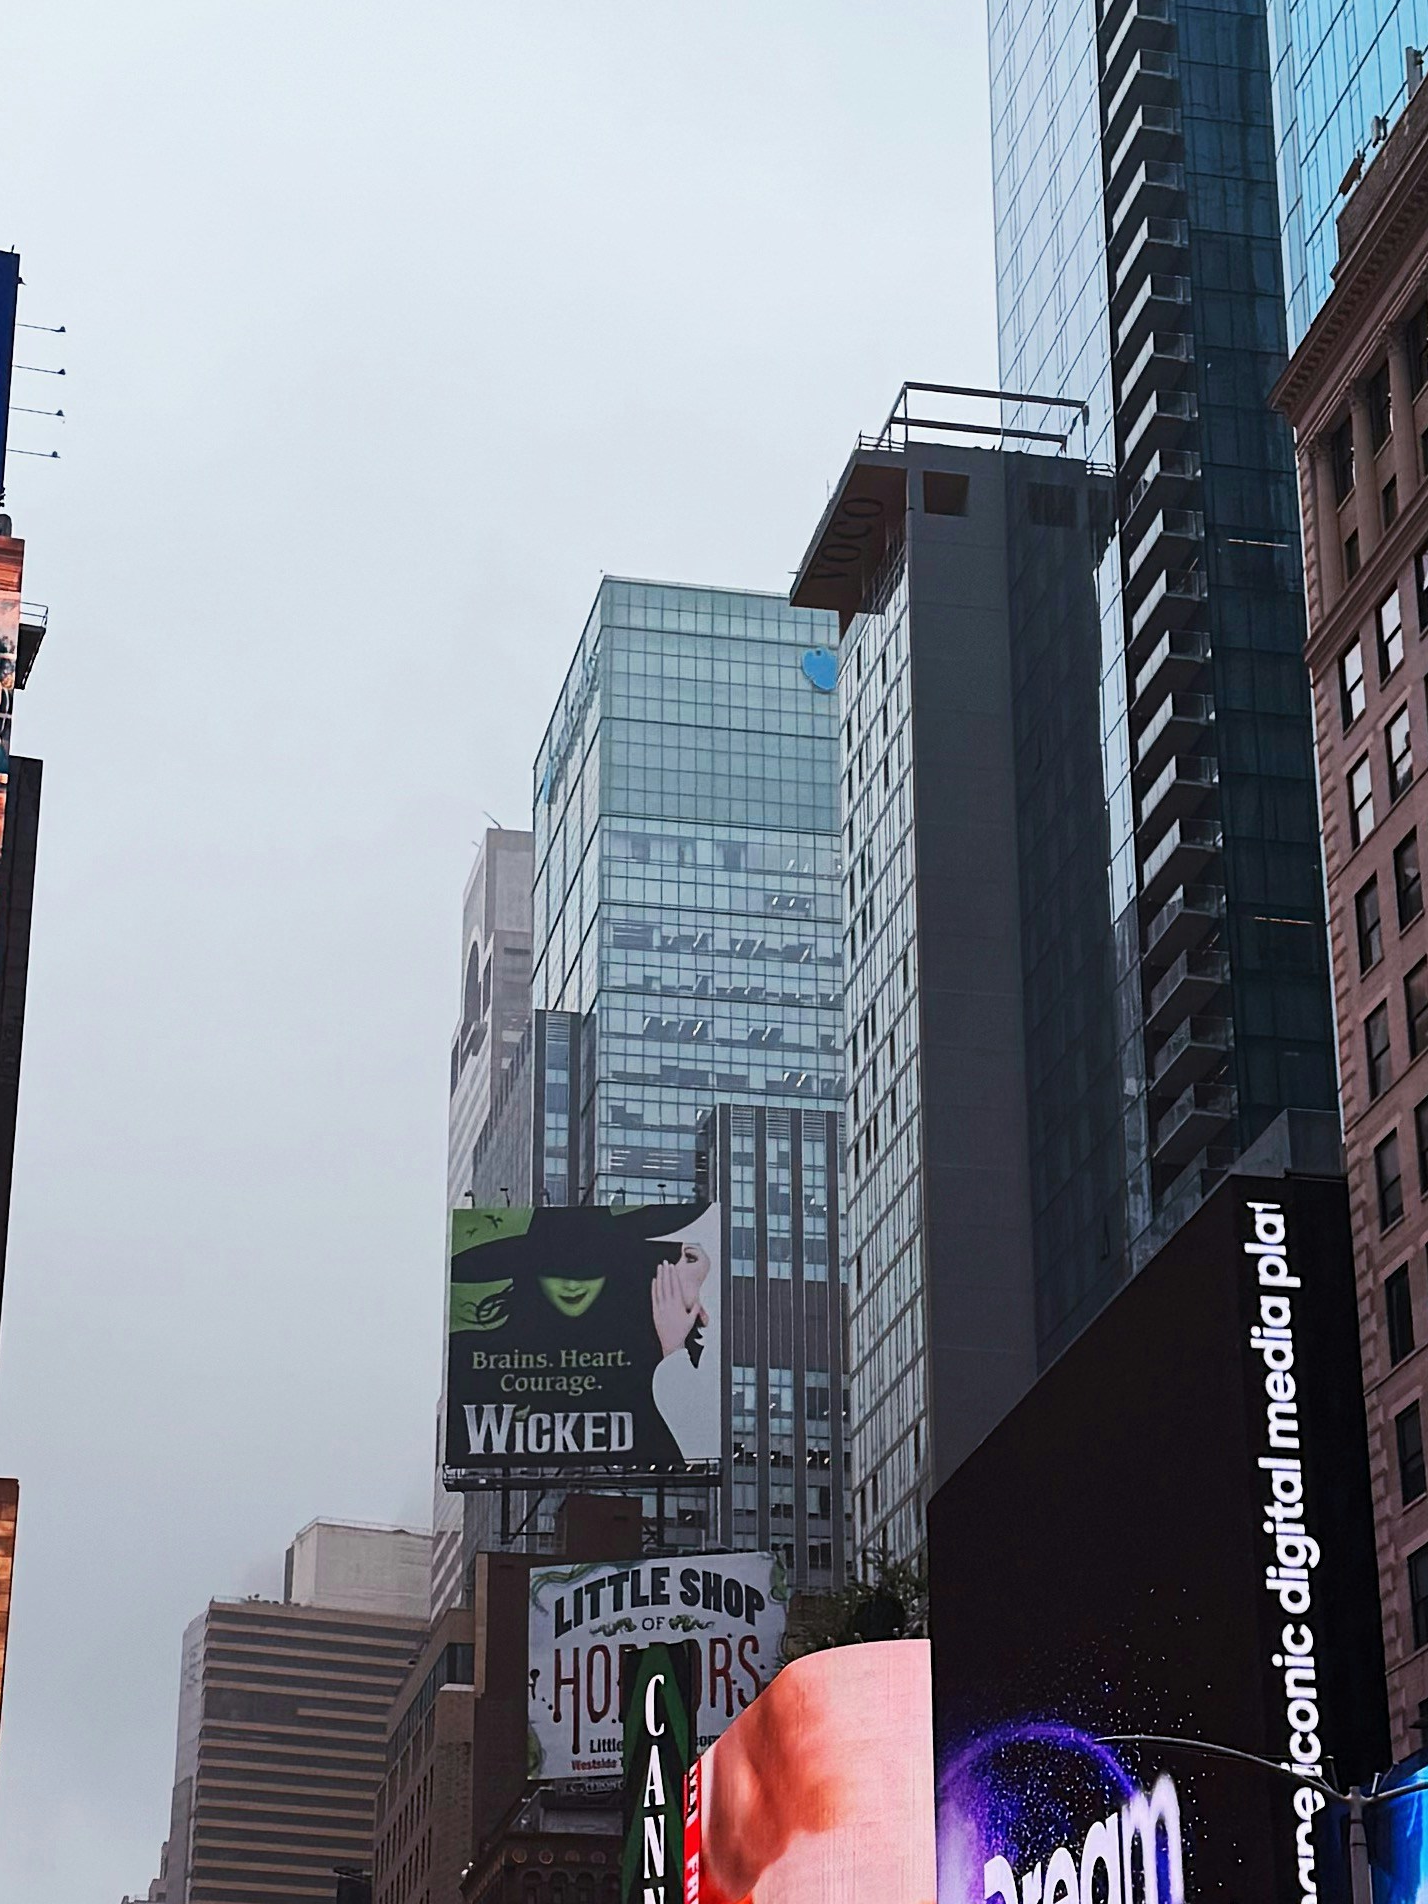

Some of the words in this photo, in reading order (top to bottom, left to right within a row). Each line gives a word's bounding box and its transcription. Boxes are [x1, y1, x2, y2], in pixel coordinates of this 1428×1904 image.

[472, 1349, 554, 1371] Brains.
[559, 1348, 632, 1369] Heart.
[500, 1371, 603, 1395] Courage.
[1251, 1296, 1300, 1449] media
[1258, 1457, 1320, 1616] digital
[553, 1567, 671, 1639] LITTLE
[681, 1568, 765, 1627] SHOP
[642, 1616, 664, 1632] OF
[1272, 1622, 1323, 1778] iconic
